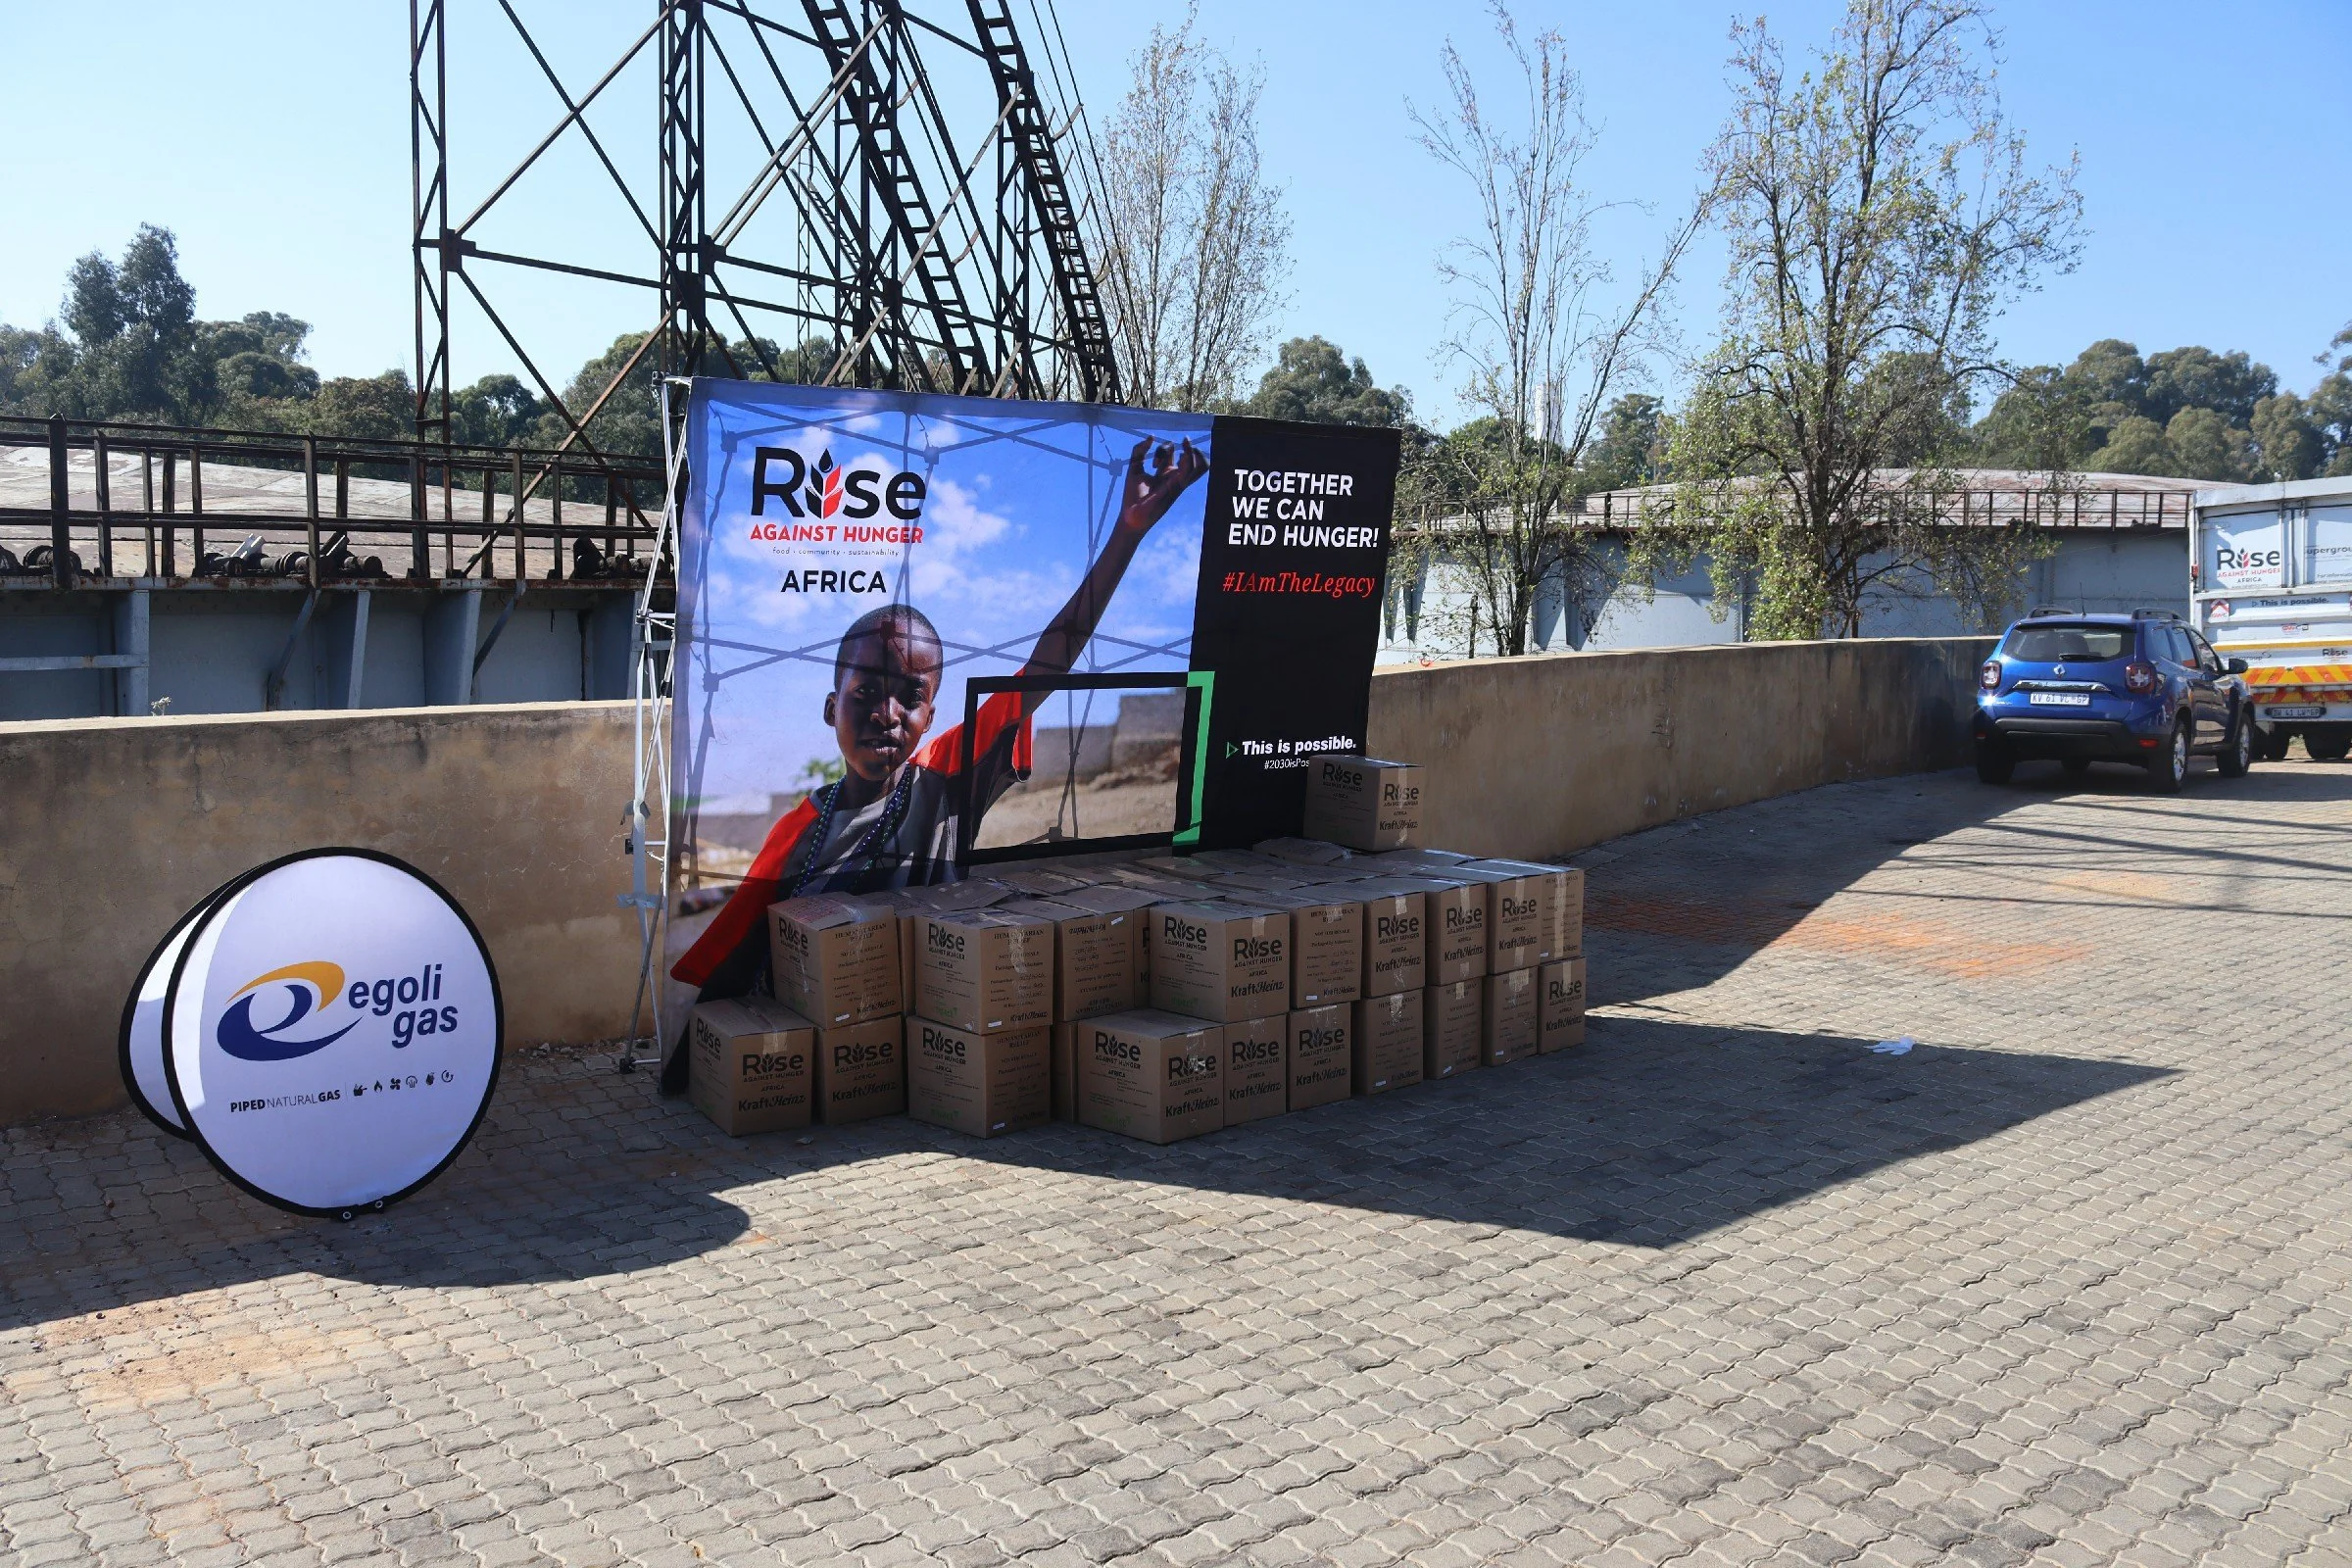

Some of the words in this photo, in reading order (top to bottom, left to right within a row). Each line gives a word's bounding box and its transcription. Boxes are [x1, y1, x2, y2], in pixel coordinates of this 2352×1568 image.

[751, 447, 926, 520] Rise
[1234, 469, 1353, 496] TOGETHER
[1232, 496, 1270, 519] WE
[1276, 498, 1324, 521] CAN
[751, 524, 837, 542] AGAINST
[843, 526, 924, 544] HUNGER
[1228, 522, 1277, 546] END
[1283, 524, 1379, 548] HUNGER!
[781, 570, 887, 593] AFRICA
[1223, 571, 1376, 598] #IAmTheLegacy
[2290, 597, 2329, 606] possible.
[1242, 740, 1273, 756] This
[1277, 739, 1291, 754] is
[1295, 736, 1356, 756] possible.
[1235, 937, 1282, 960] Rise
[348, 963, 443, 1016] egoli
[391, 1005, 459, 1049] gas
[743, 1053, 804, 1075] Rise
